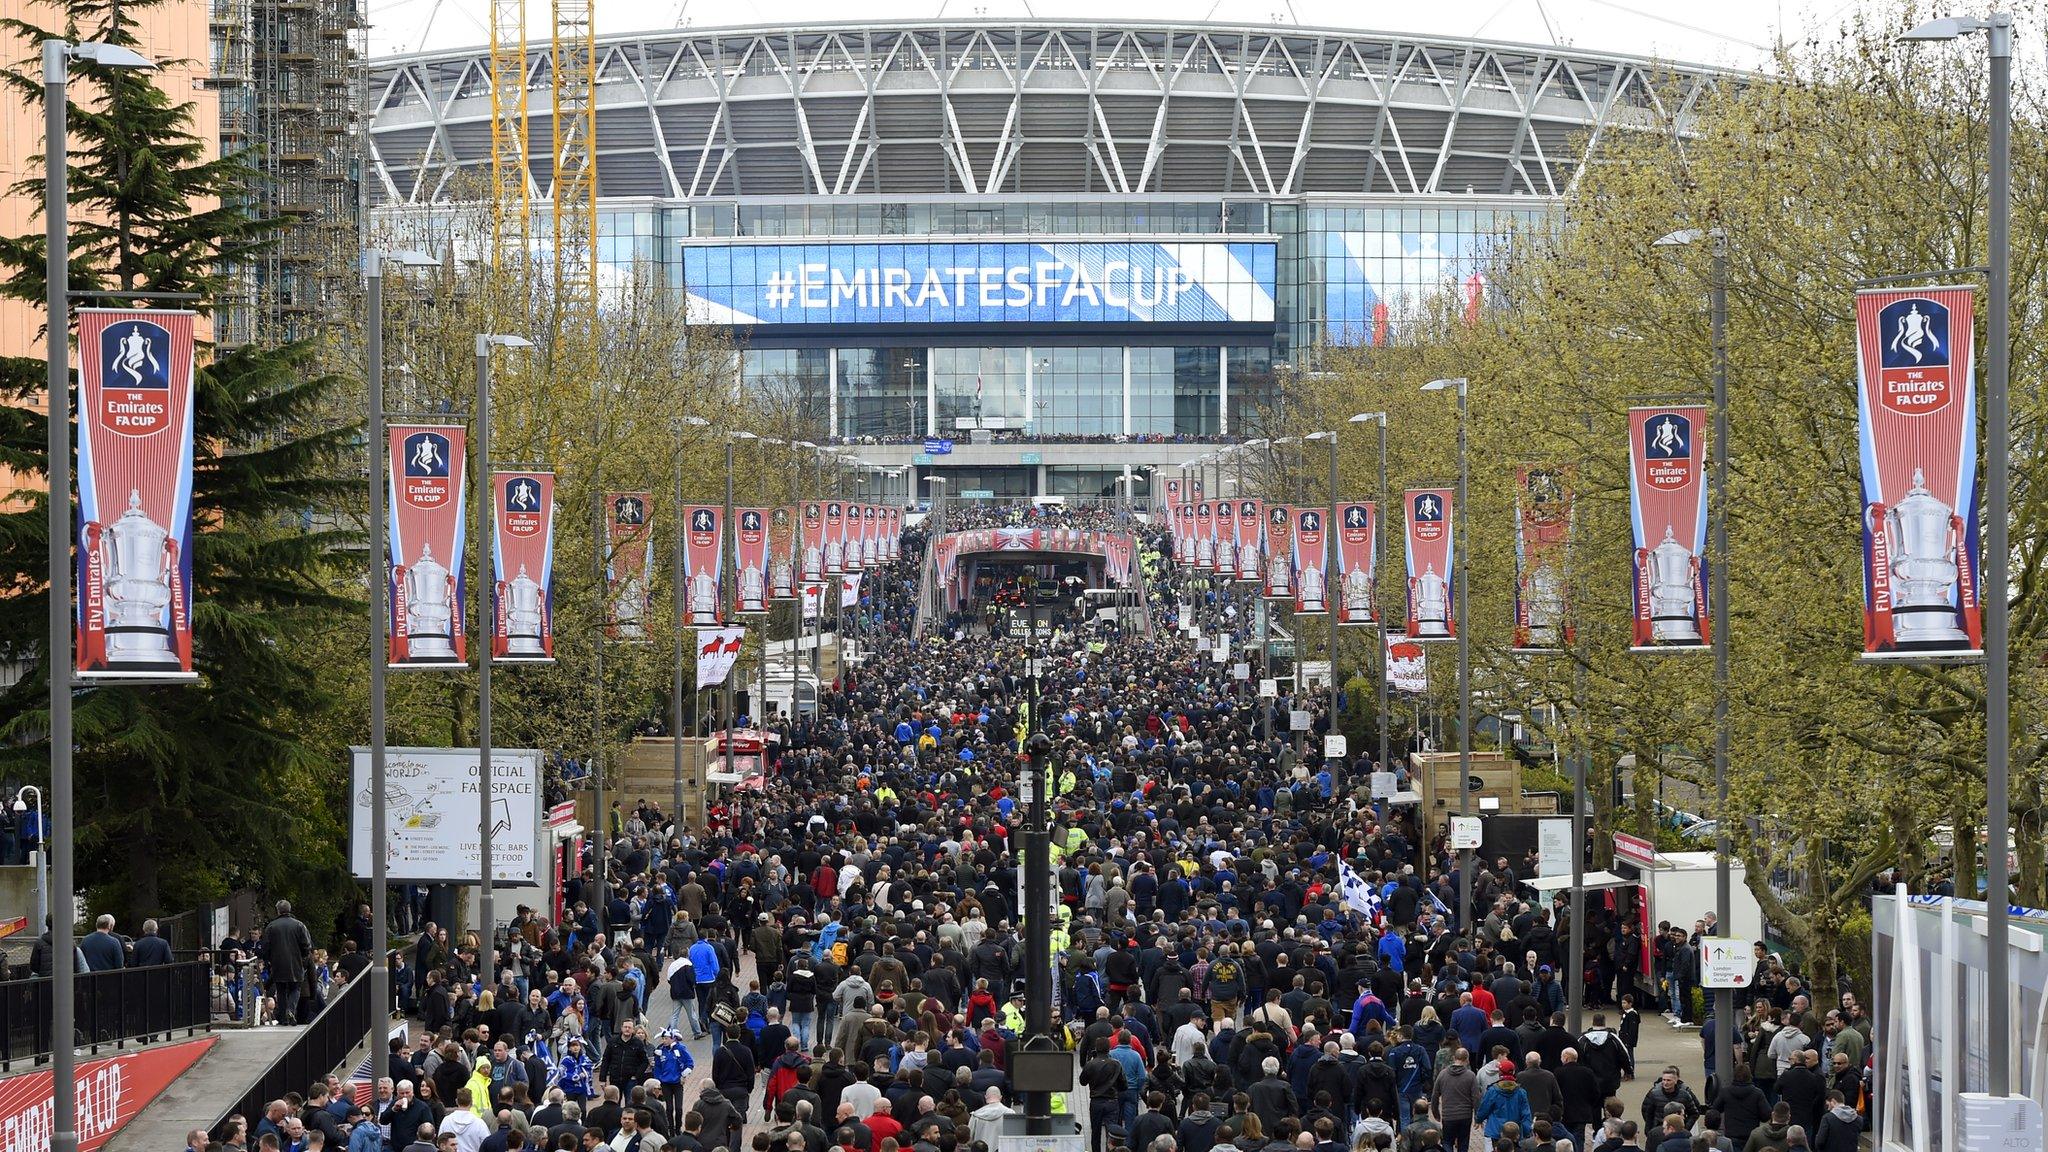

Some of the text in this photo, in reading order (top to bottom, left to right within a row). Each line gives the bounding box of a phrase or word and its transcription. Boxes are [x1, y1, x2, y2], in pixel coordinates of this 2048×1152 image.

[1907, 371, 1923, 379] THE
[1888, 379, 1945, 393] Emirates
[127, 393, 143, 401] THE
[1896, 394, 1937, 406] FA CUP
[108, 401, 163, 414] Emirates
[115, 416, 156, 426] FA CUP
[1650, 467, 1687, 476] Emirates
[408, 485, 446, 494] Emirates
[413, 494, 441, 502] FA CUP
[509, 518, 538, 526] Emirates
[1873, 531, 1890, 612] Fly Emirates
[1958, 541, 1974, 608] Fly Emirates
[87, 550, 104, 631] Fly Emirates
[1639, 566, 1650, 620] Fly Emirates
[170, 564, 186, 631] Fly Emirates
[396, 583, 407, 637] Fly Emirates
[469, 766, 526, 777] OICIAL
[508, 843, 528, 851] BARS
[77, 1077, 94, 1144] FA
[96, 1063, 121, 1133] CUP
[2003, 1137, 2031, 1148] ALTO
